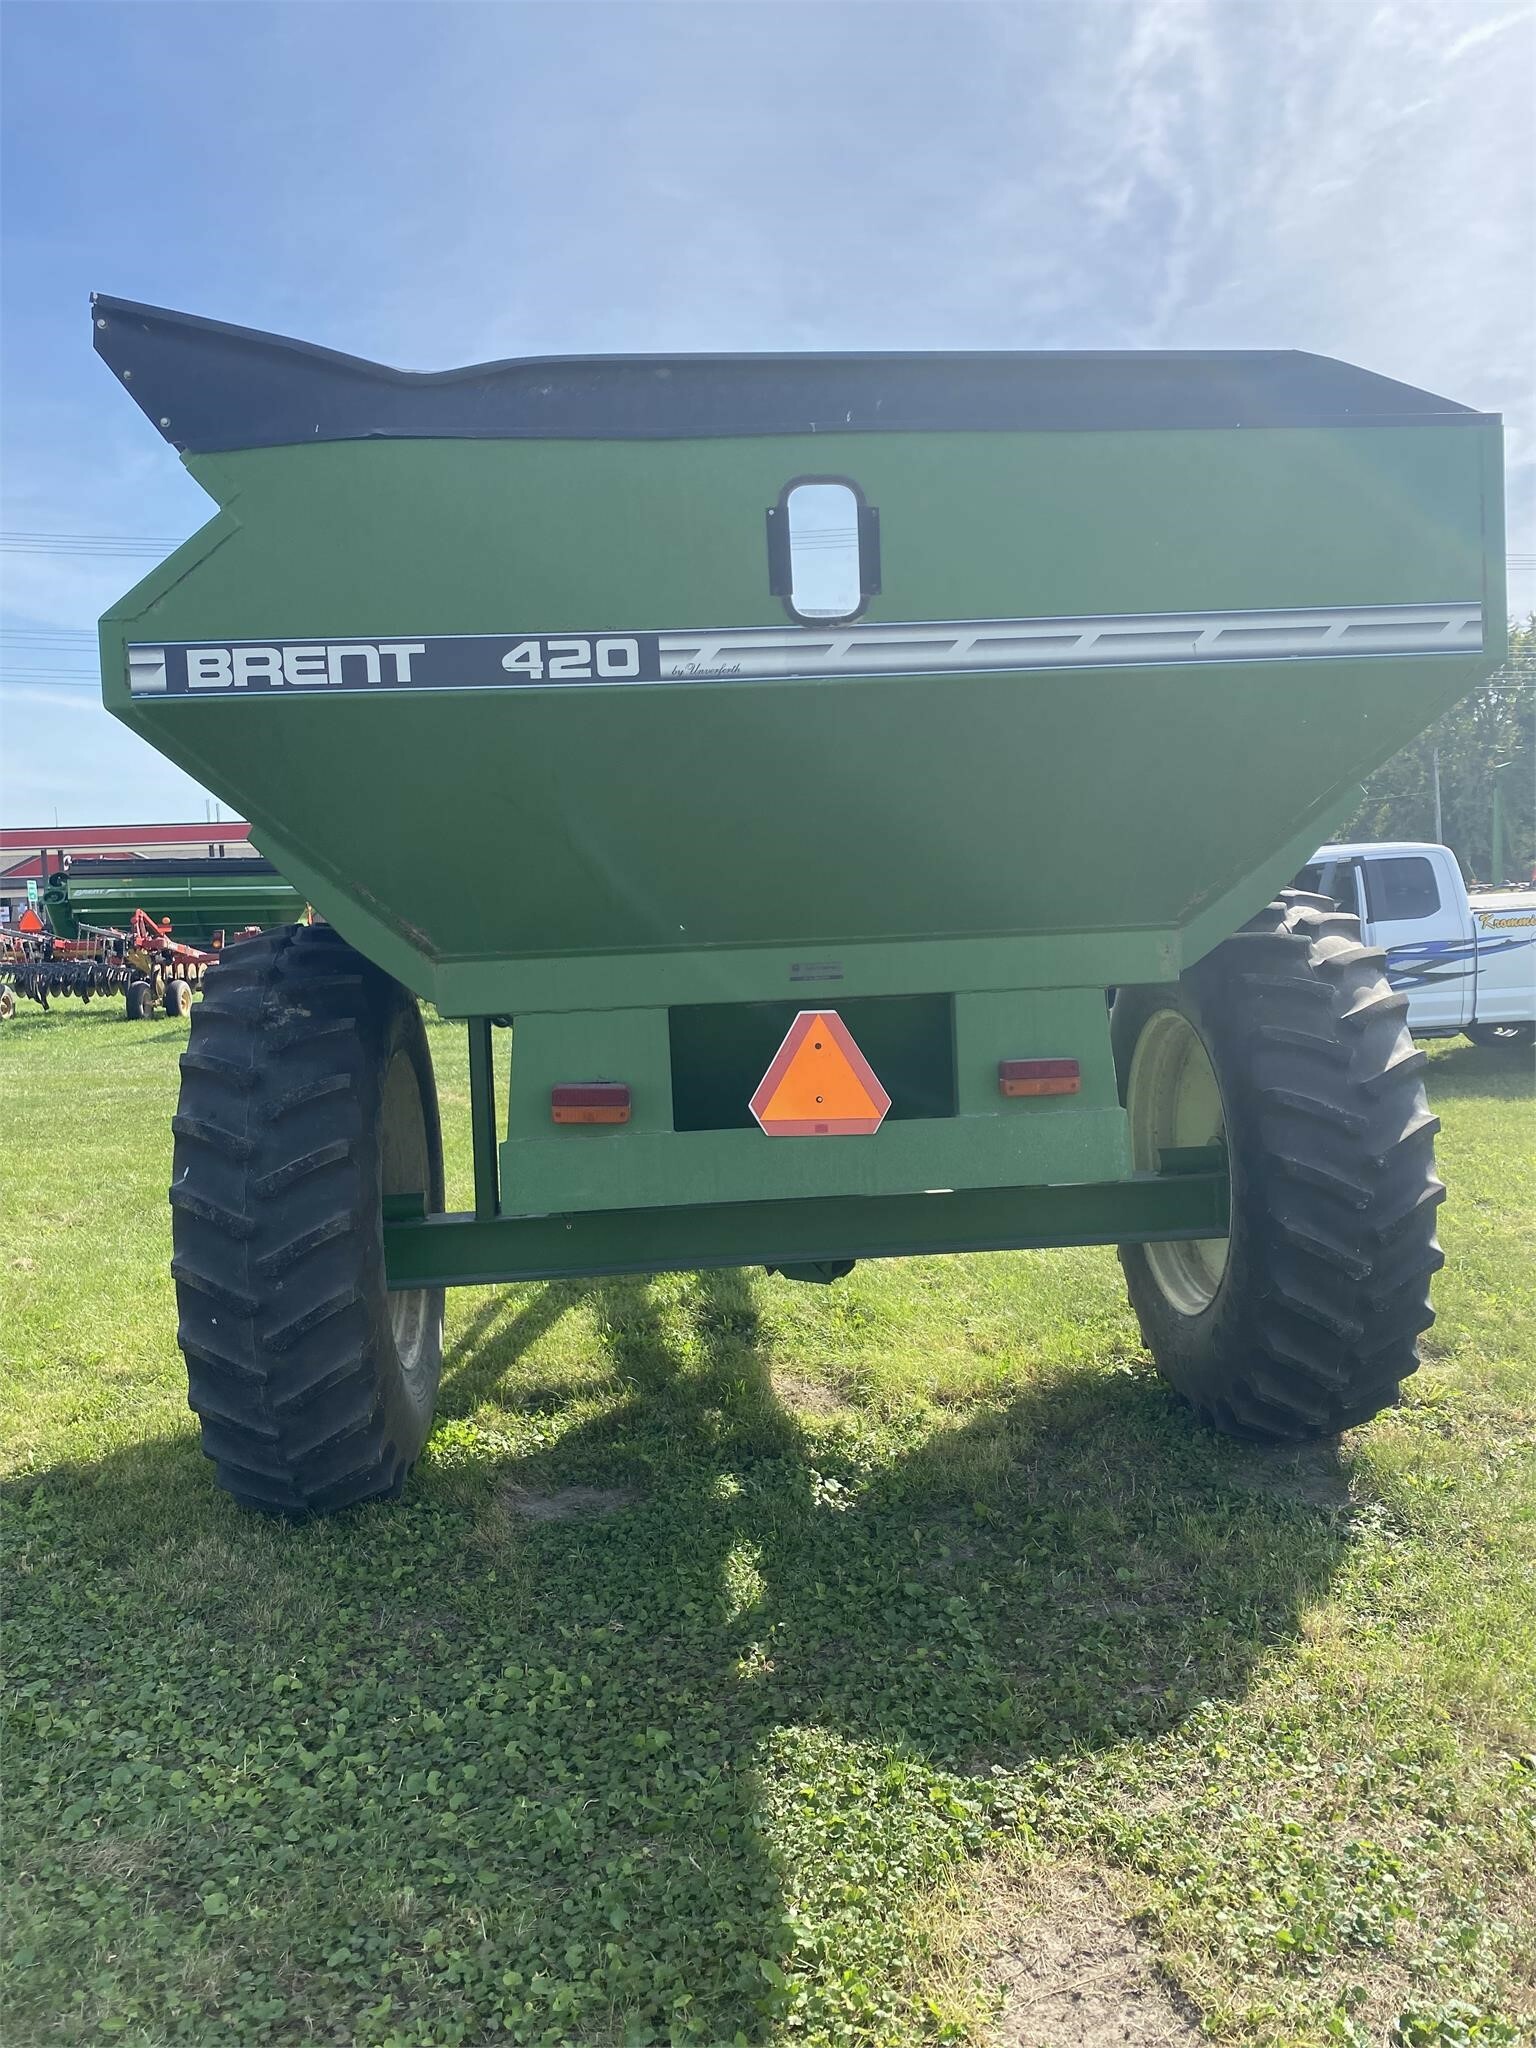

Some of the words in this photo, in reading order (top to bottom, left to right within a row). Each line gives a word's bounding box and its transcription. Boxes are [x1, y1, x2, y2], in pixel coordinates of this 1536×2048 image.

[186, 643, 426, 688] BRENT
[501, 638, 640, 679] 420
[671, 664, 684, 678] by
